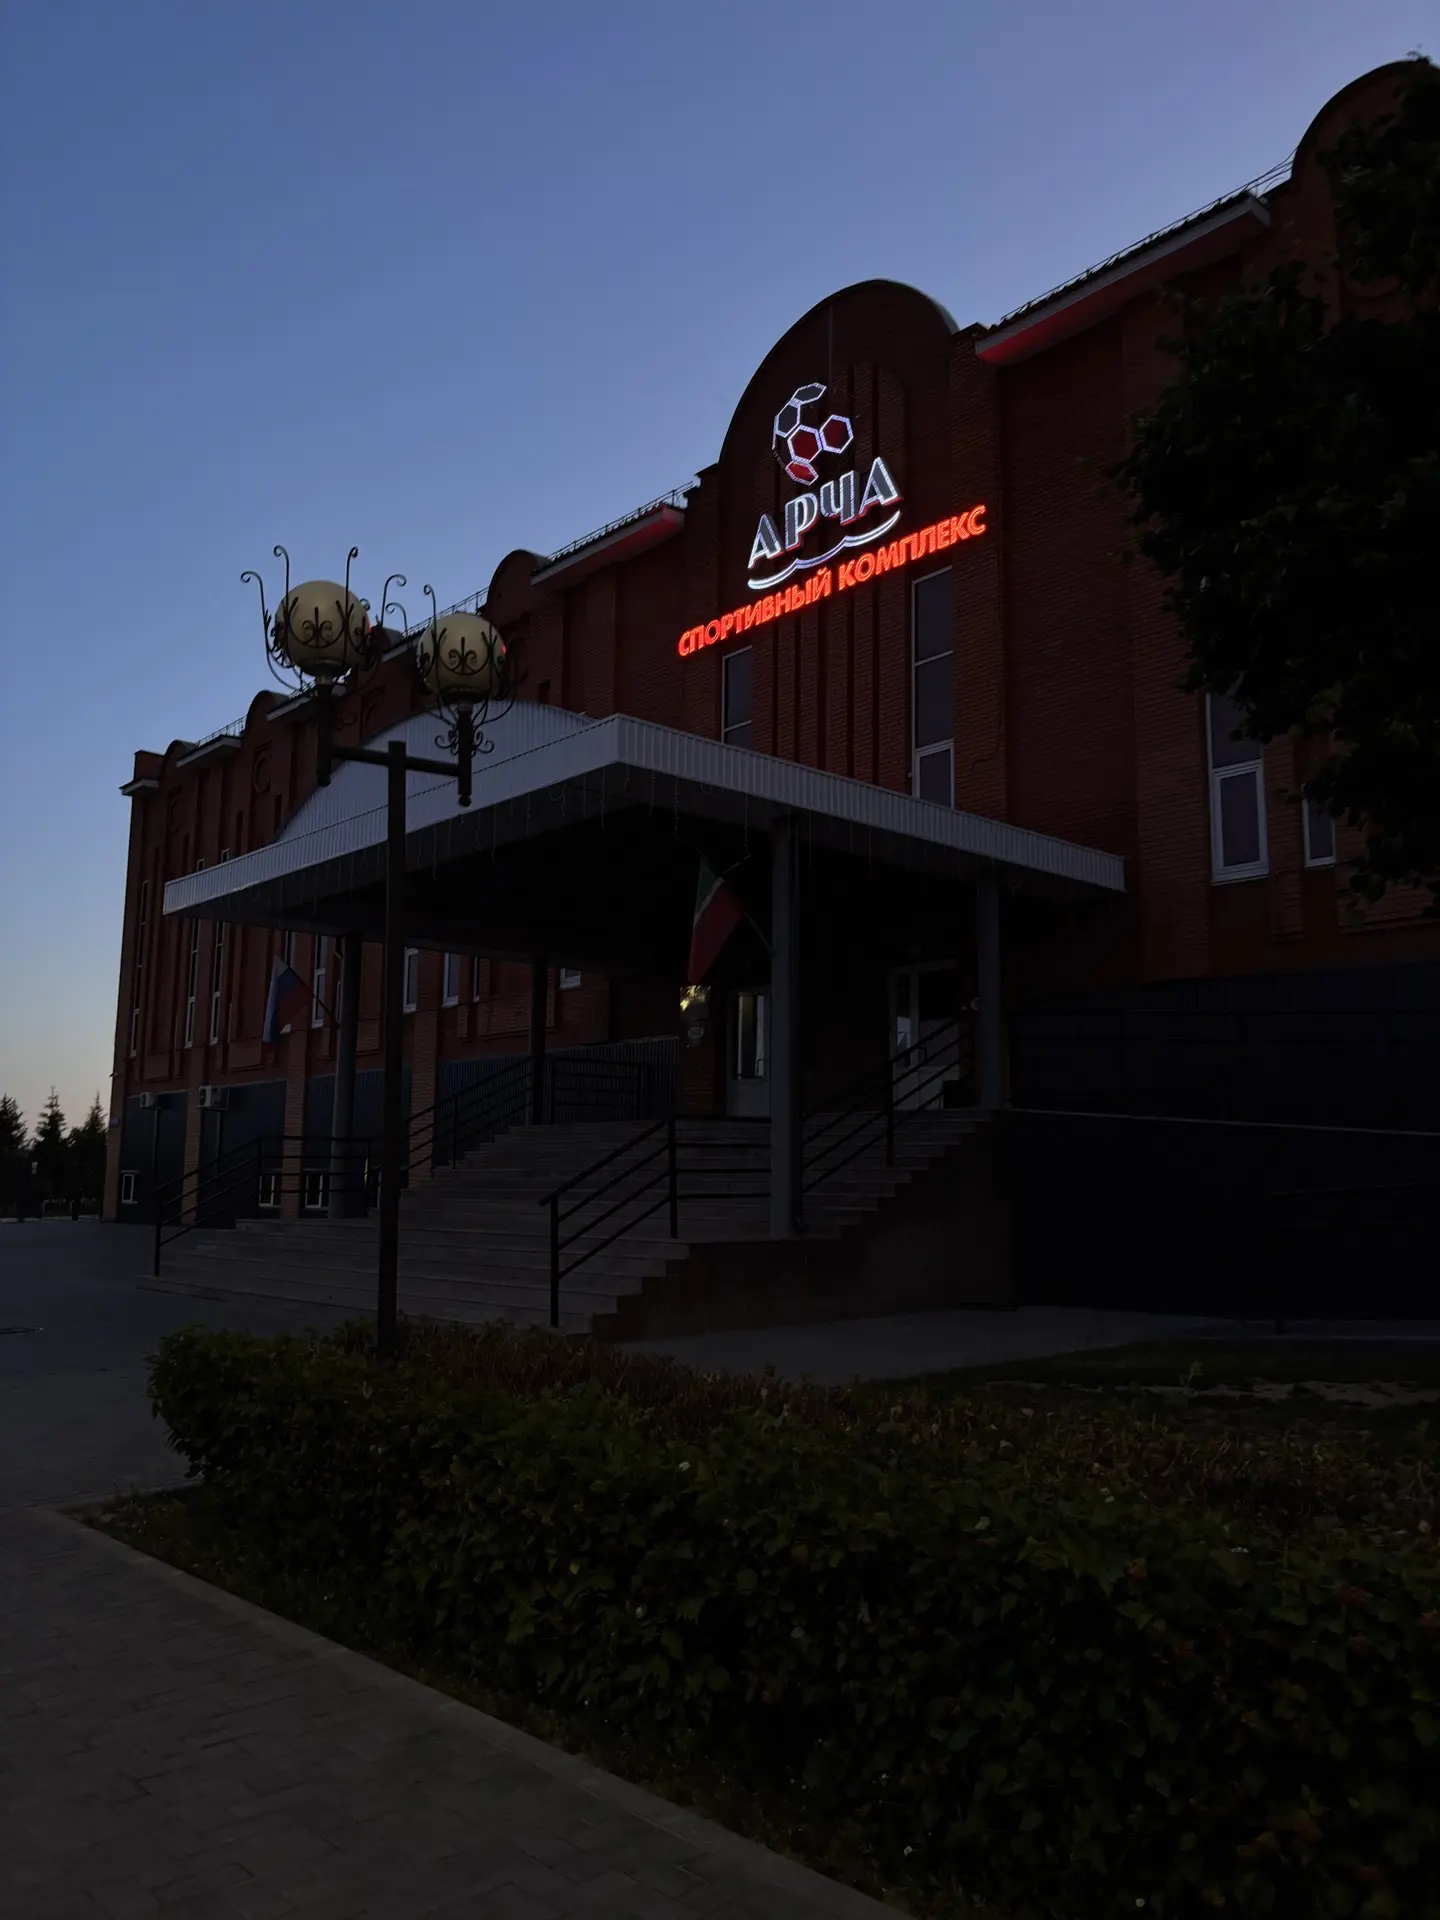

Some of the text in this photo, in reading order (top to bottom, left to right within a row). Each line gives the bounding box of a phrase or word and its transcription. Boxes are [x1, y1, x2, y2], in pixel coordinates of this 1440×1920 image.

[748, 457, 902, 569] АРЧА
[678, 505, 987, 656] СПОРТИВНЫЙ КОМПЛЕКС
